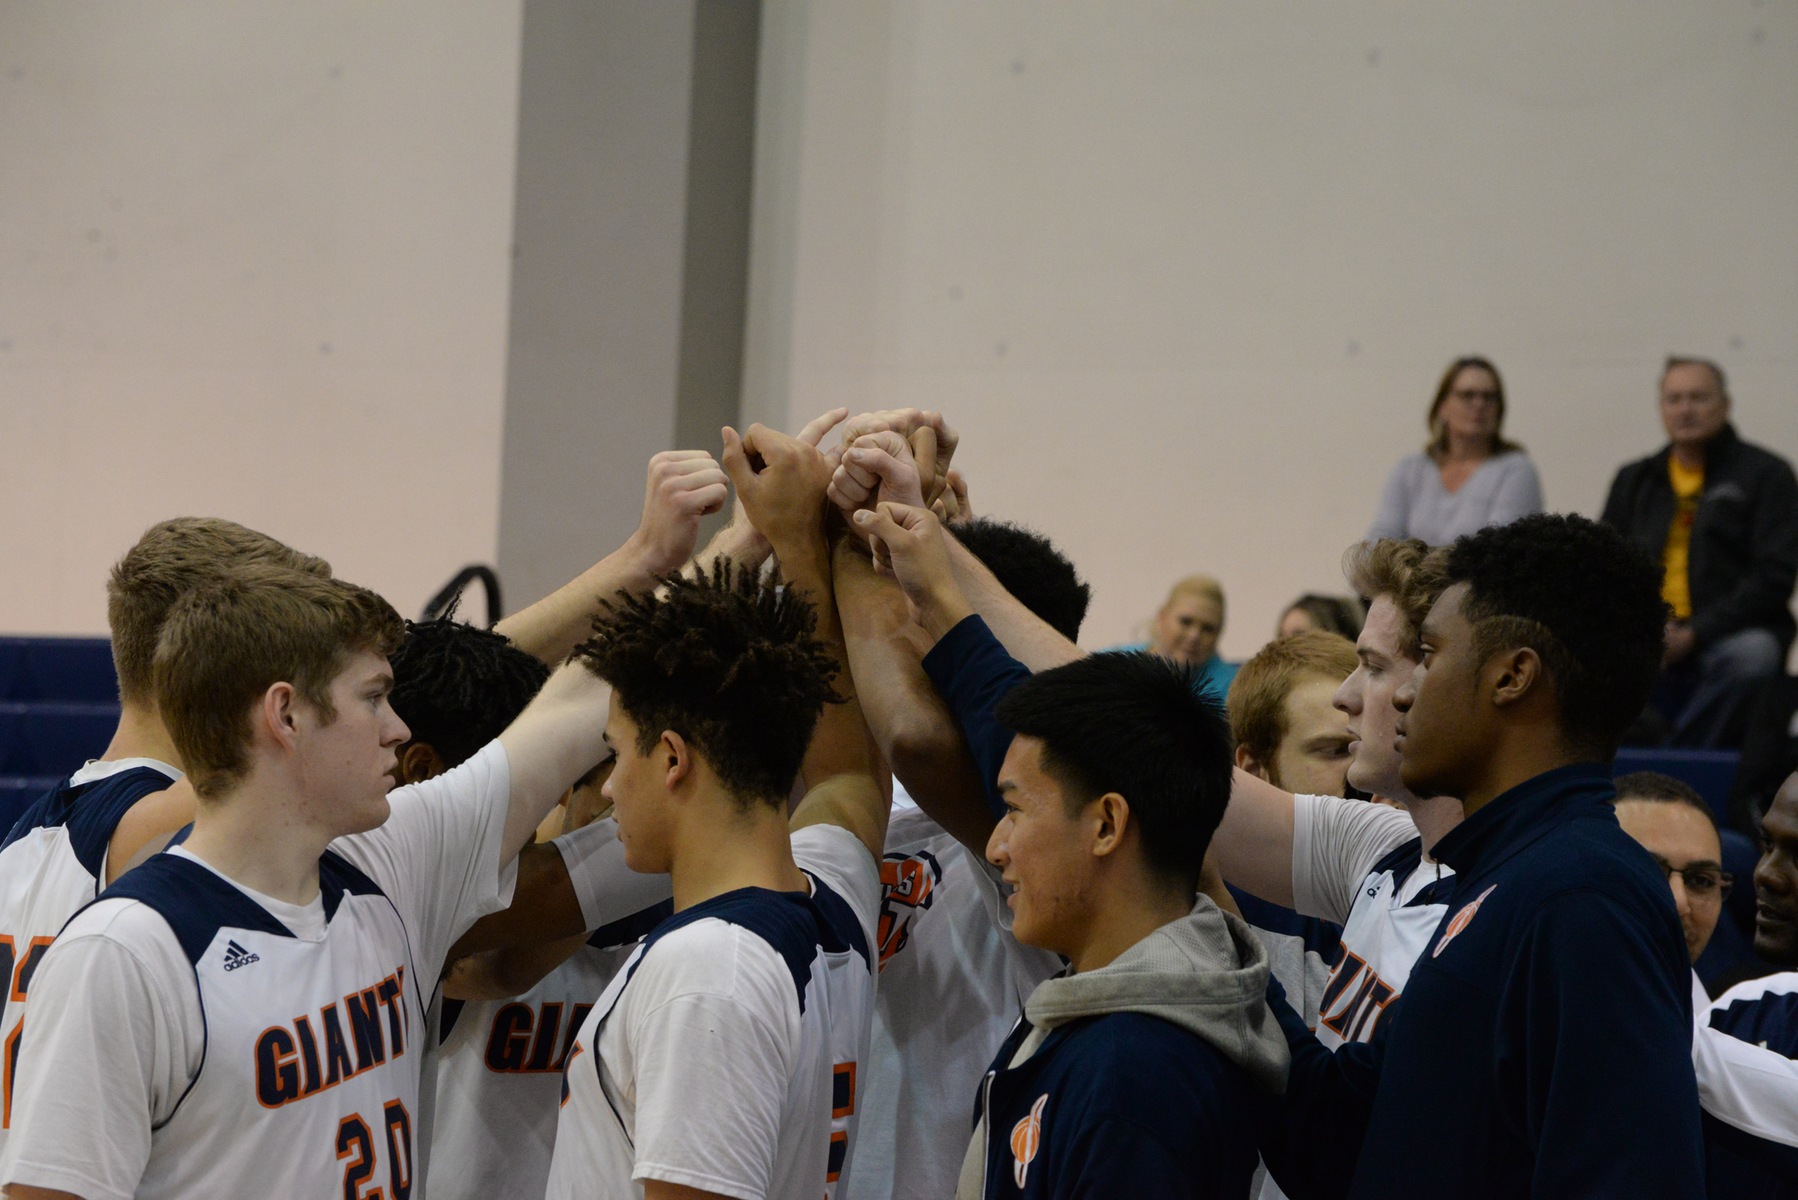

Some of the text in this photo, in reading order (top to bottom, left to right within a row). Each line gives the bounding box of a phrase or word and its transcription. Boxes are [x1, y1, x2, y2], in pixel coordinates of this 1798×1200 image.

[224, 953, 260, 972] adidas
[254, 964, 410, 1109] GIANT
[335, 1097, 412, 1200] 20
